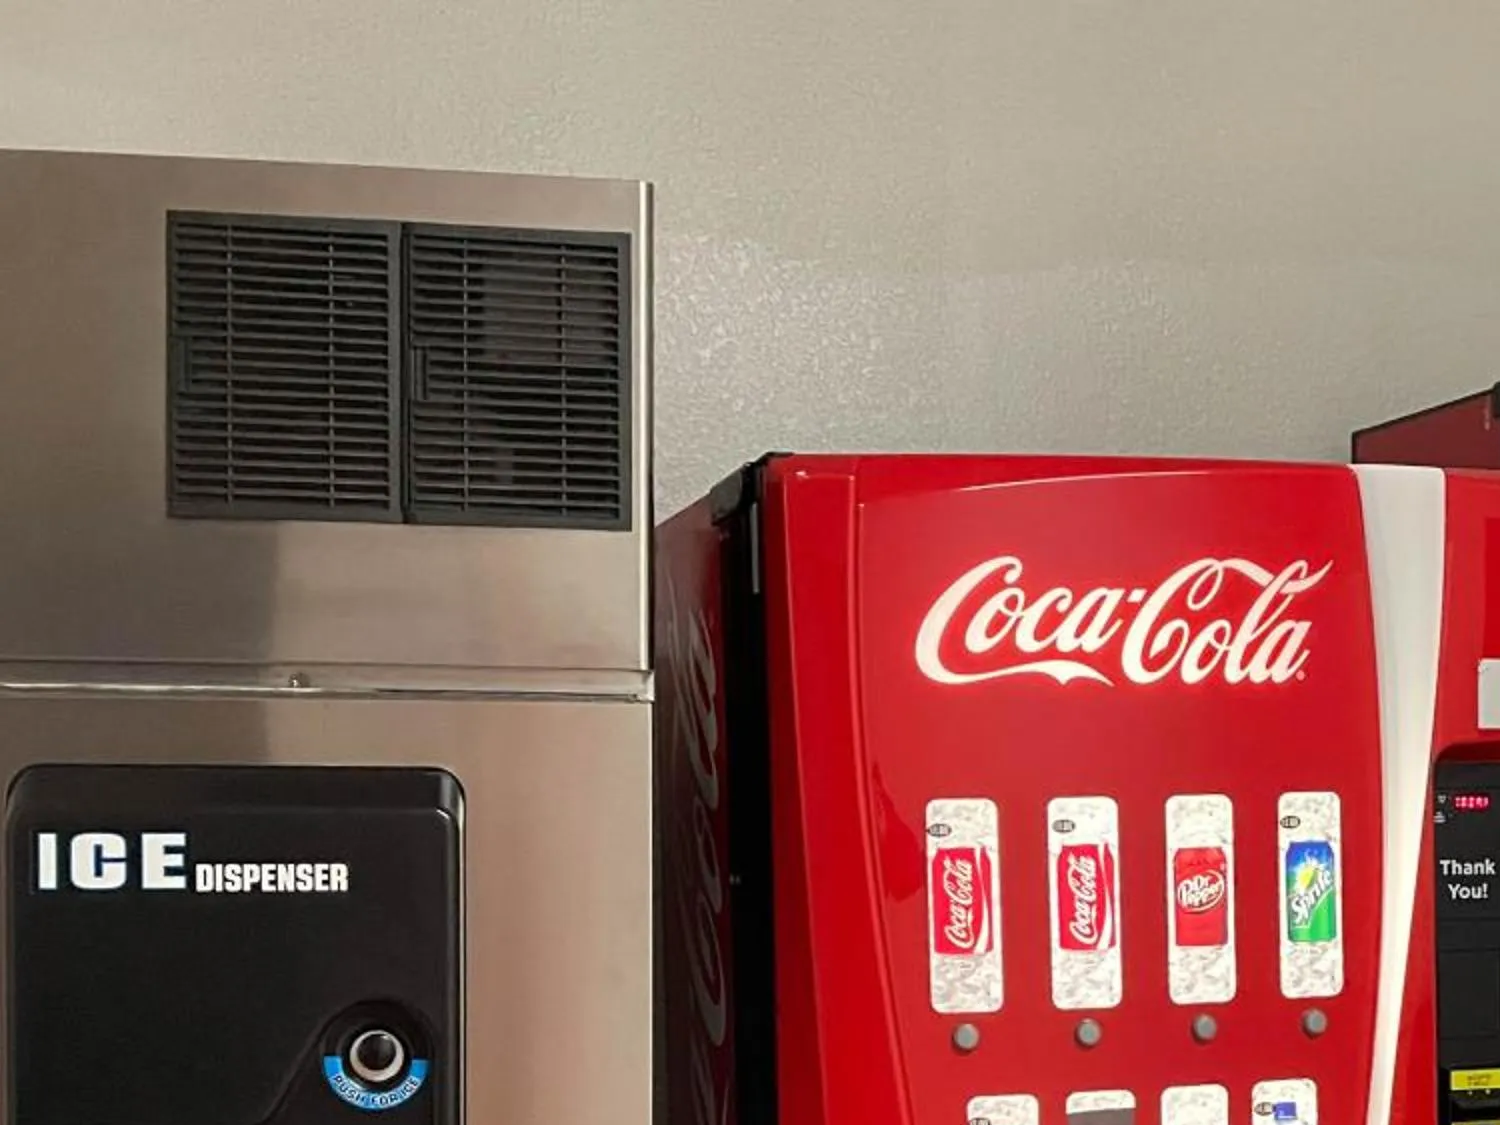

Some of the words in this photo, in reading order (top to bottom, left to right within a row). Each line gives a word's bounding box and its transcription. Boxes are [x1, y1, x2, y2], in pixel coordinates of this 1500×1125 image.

[914, 554, 1334, 688] Coca-Cola
[37, 832, 187, 889] ICE
[196, 862, 349, 892] DISPENSER
[1439, 858, 1497, 875] Thank
[1447, 882, 1489, 900] You!
[943, 854, 975, 949] Coca-Cola
[1067, 852, 1099, 945] Coca-Cola
[1291, 867, 1333, 926] Sprite
